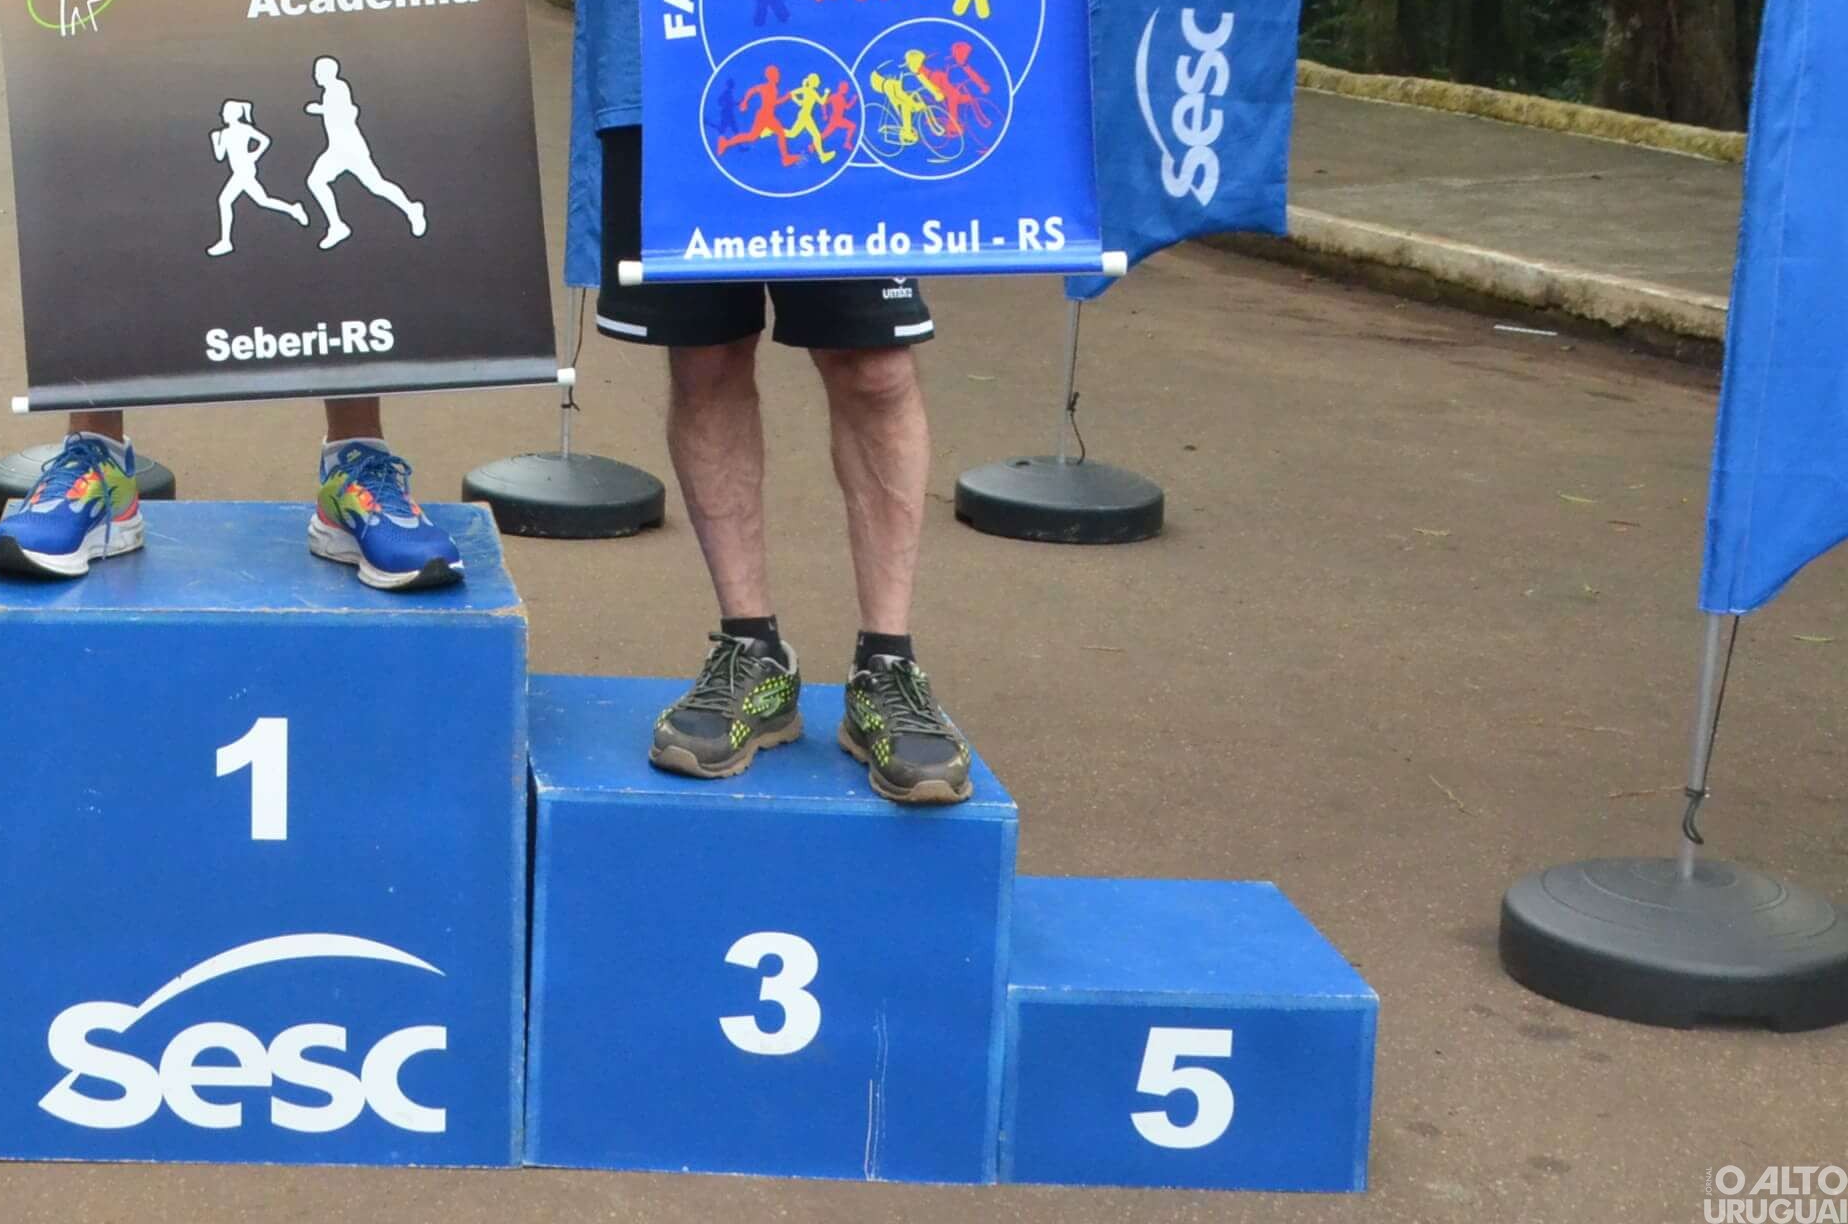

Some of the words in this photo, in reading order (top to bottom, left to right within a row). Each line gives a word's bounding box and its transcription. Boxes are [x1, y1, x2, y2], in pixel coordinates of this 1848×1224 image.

[1160, 8, 1235, 207] Sesc
[684, 227, 854, 261] Ametista
[866, 223, 911, 257] do
[922, 219, 981, 255] Sul
[1018, 217, 1066, 253] RS
[205, 318, 395, 363] Seberi-RS
[215, 717, 289, 841] 1
[718, 931, 822, 1056] 3
[38, 981, 447, 1134] Sesc
[1130, 1027, 1235, 1149] 5
